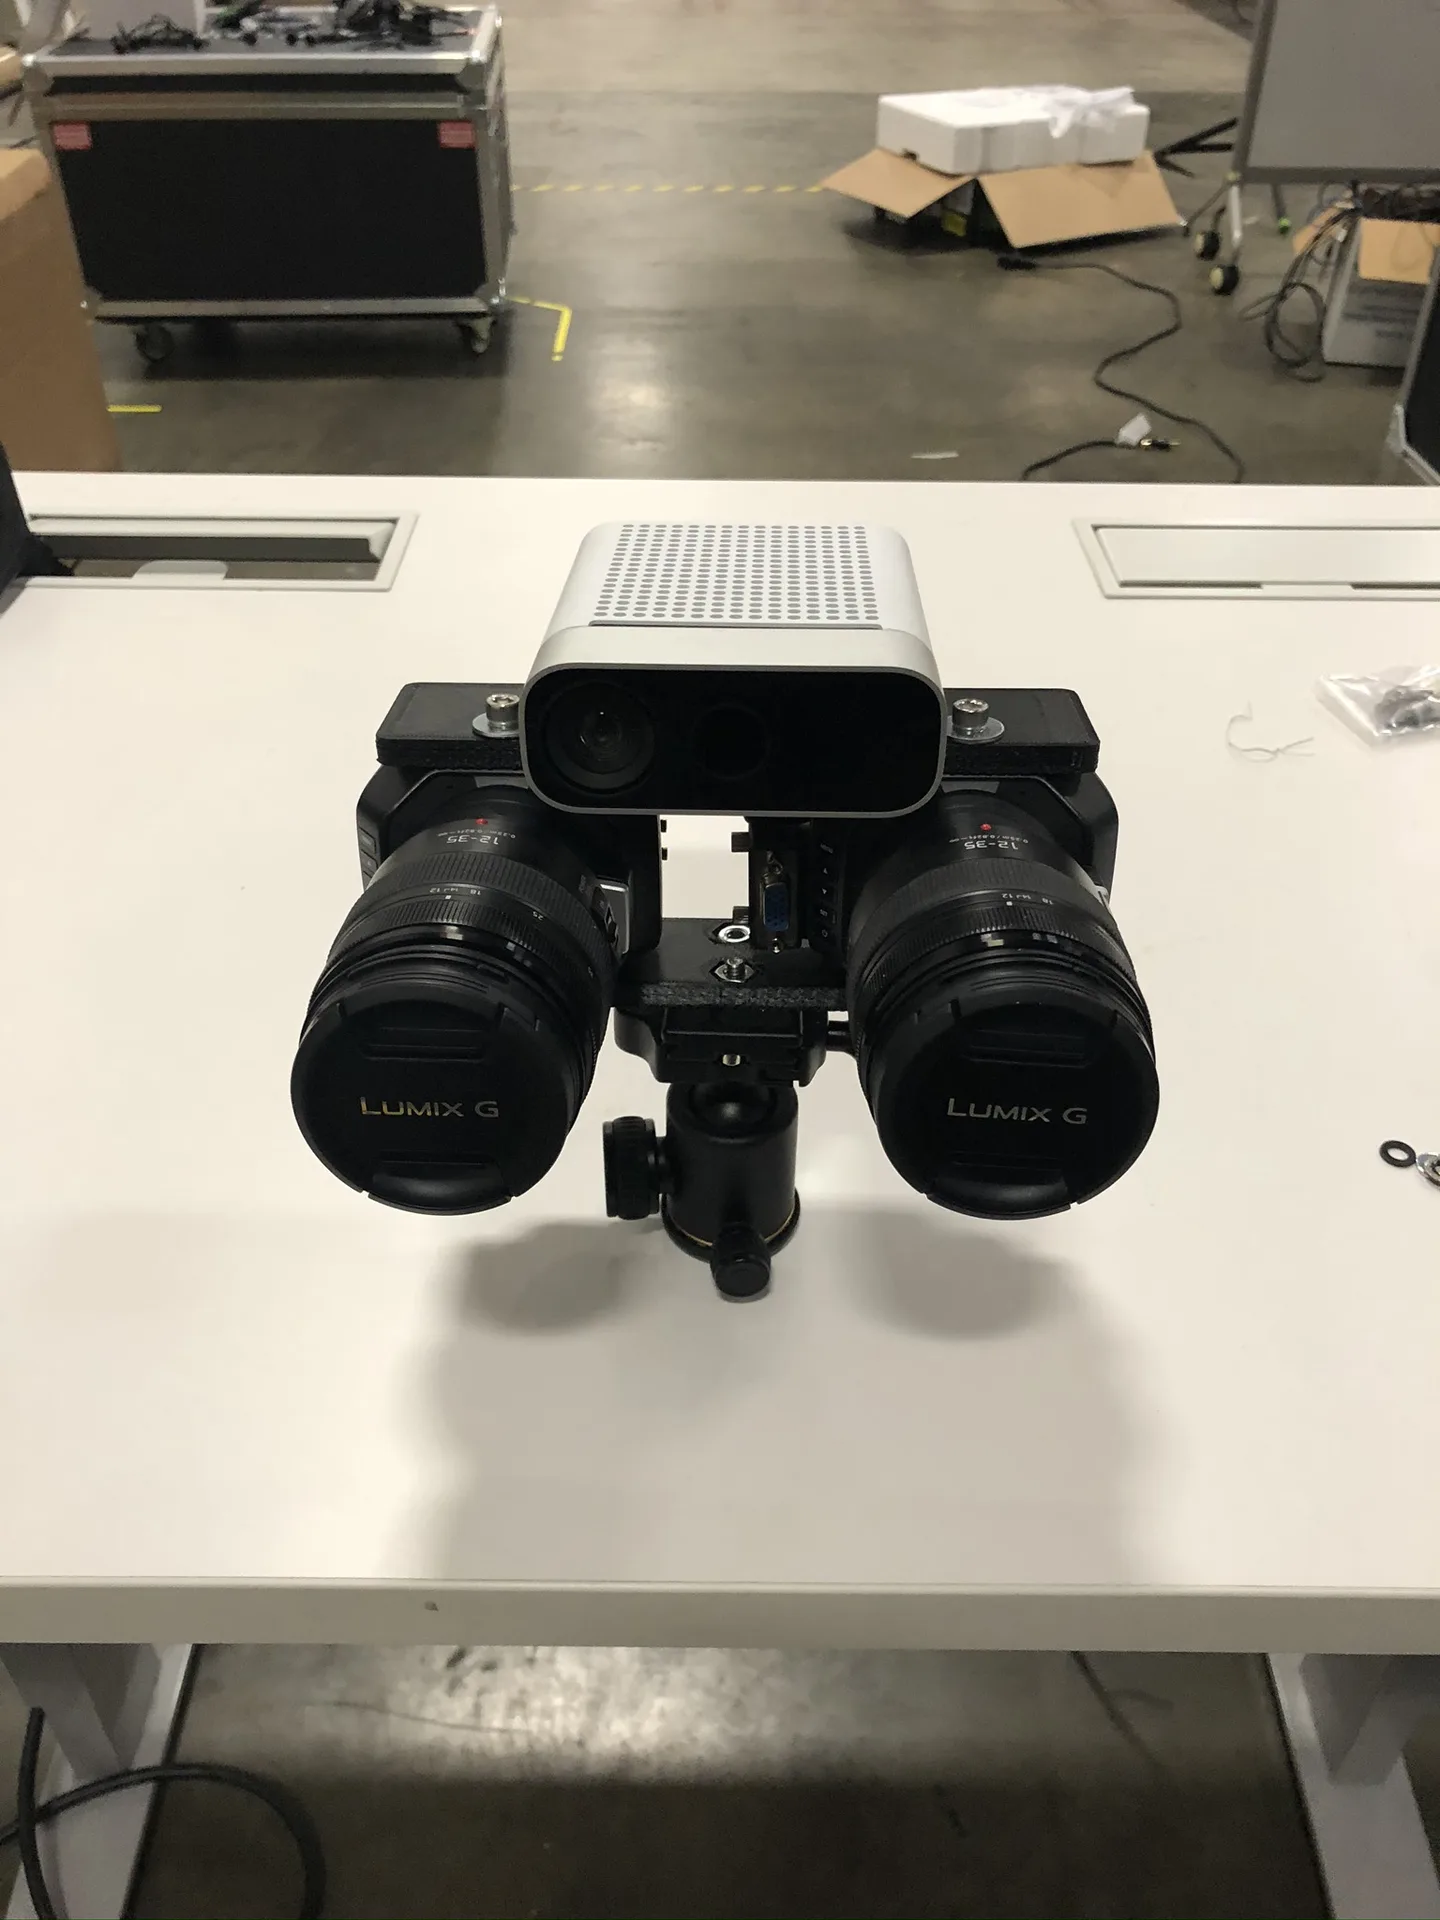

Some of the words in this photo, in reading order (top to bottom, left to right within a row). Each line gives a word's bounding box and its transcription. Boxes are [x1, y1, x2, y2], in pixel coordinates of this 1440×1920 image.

[446, 834, 499, 845] 12-35
[964, 840, 1019, 850] 12-35
[359, 1096, 465, 1117] LUMIX
[474, 1100, 500, 1118] G
[947, 1097, 1052, 1123] LUMIX
[1062, 1107, 1088, 1125] G
